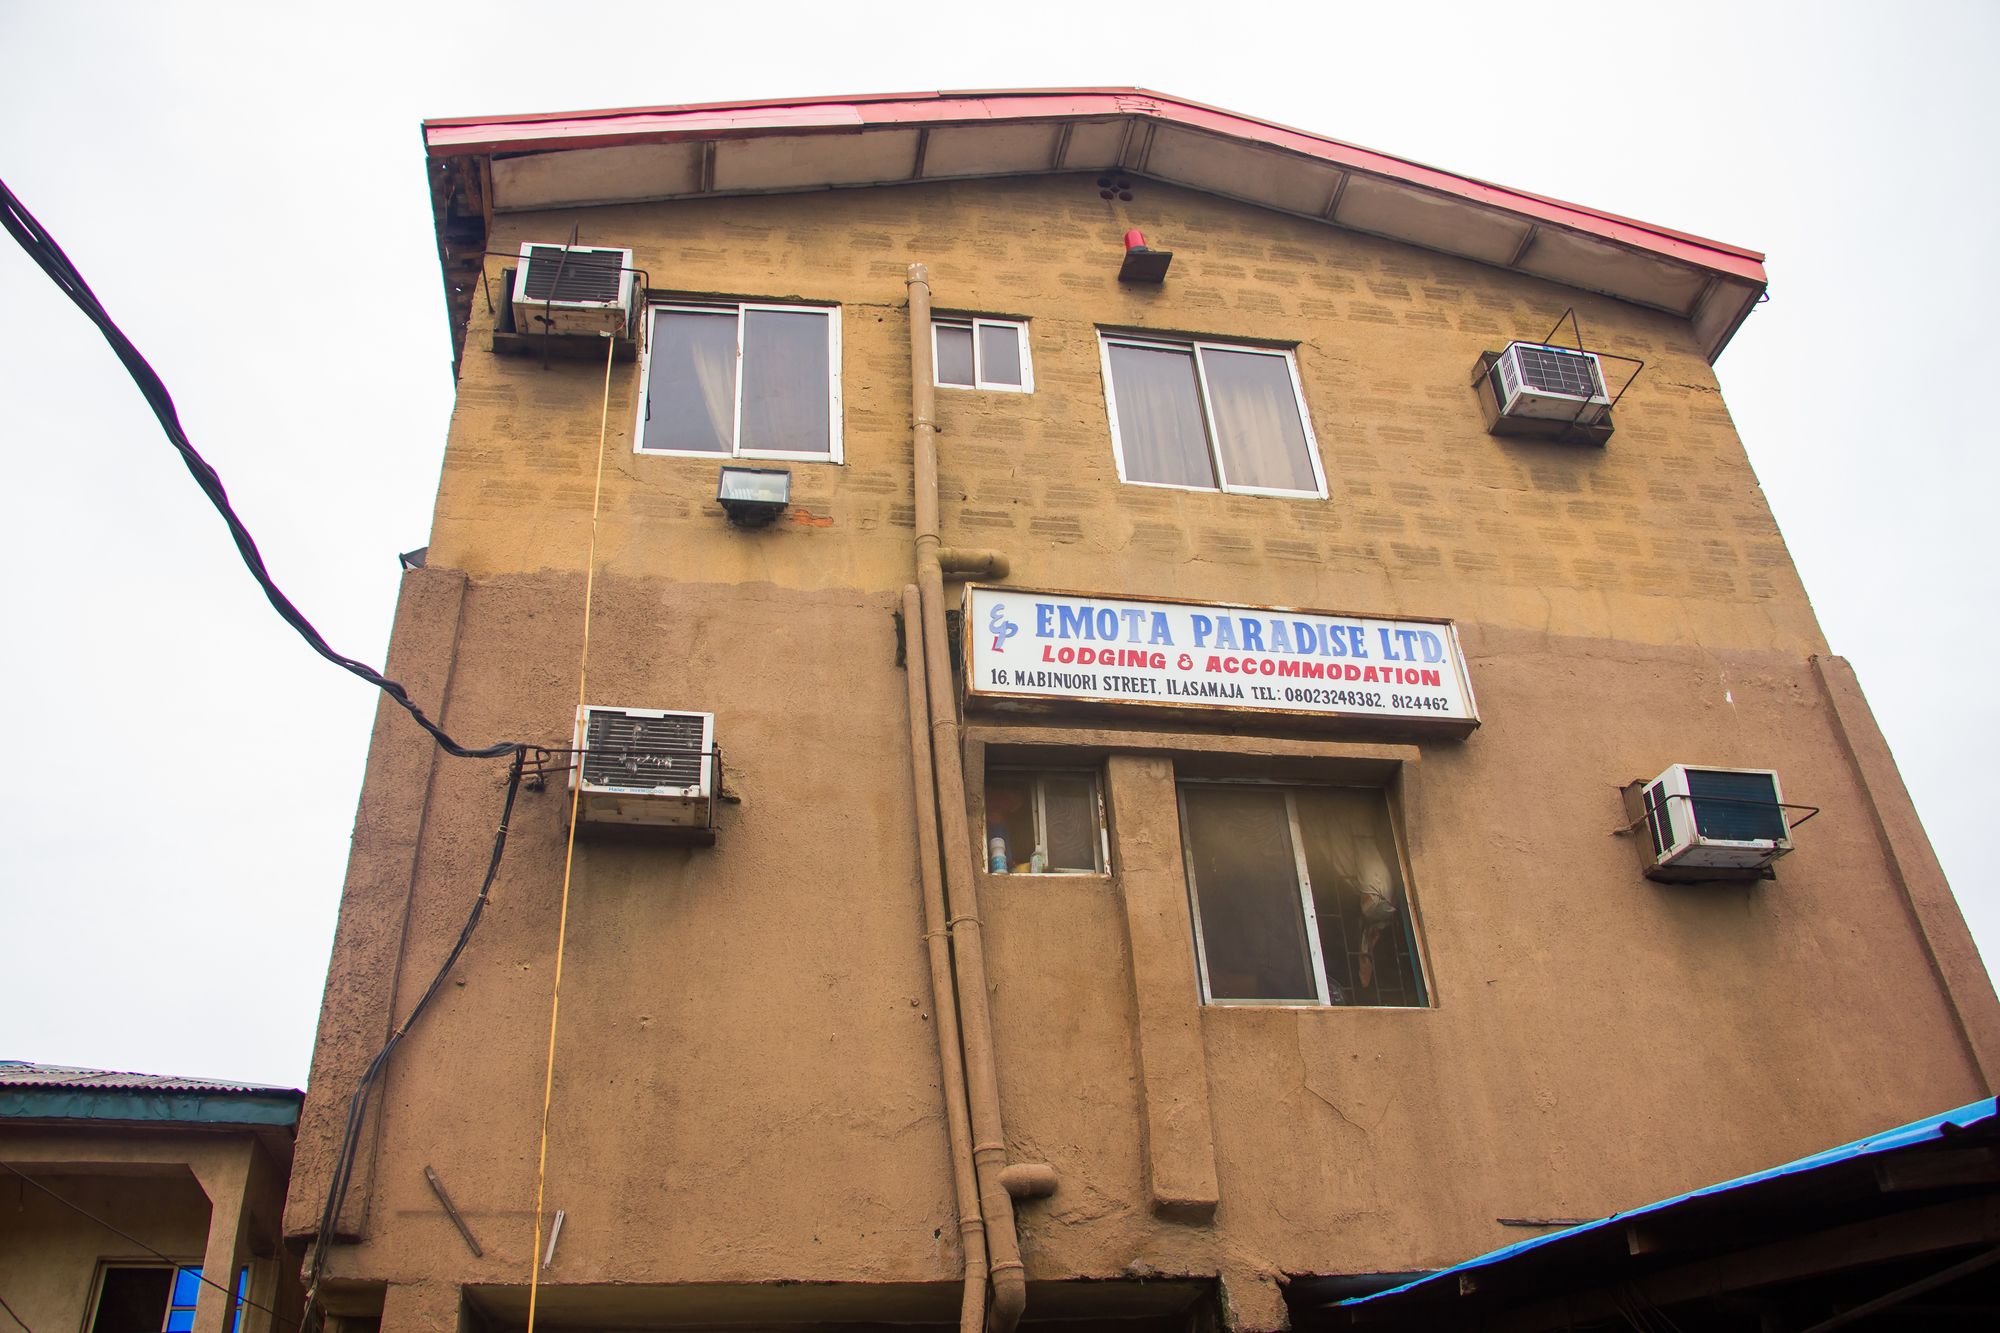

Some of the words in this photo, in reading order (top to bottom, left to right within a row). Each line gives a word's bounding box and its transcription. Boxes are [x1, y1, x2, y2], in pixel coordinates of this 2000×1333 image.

[1035, 603, 1174, 646] EMOTA
[1190, 614, 1369, 659] PARADISE
[1378, 628, 1447, 663] LTD.
[1042, 645, 1166, 669] LODGING
[1177, 653, 1194, 671] &
[1205, 655, 1441, 687] ACCOMMODATION
[1015, 670, 1097, 690] MABINUORI
[1166, 678, 1244, 699] ILASAMAJA
[1251, 687, 1281, 701] TEL:
[1392, 694, 1449, 711] 8124462
